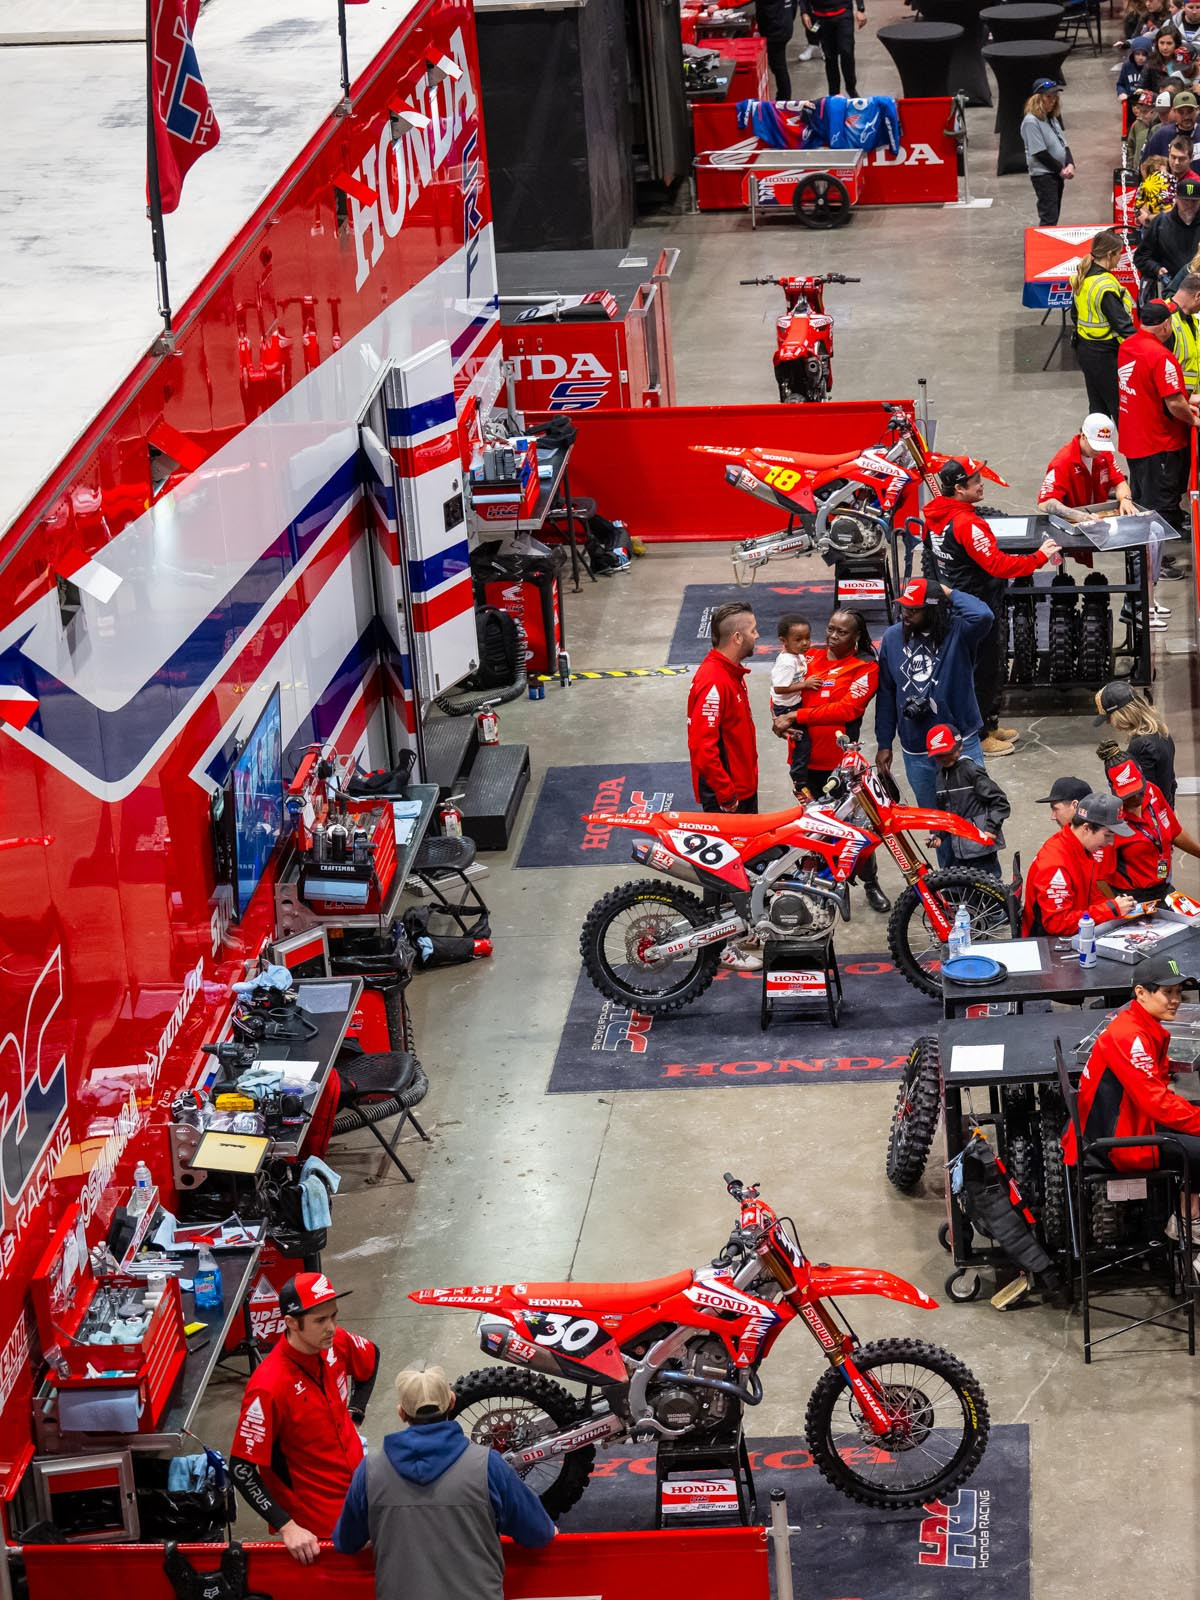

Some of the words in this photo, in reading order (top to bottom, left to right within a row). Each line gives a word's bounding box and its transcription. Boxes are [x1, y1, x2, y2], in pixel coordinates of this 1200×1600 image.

[761, 453, 796, 463] HONDA
[861, 459, 902, 476] HONDA
[767, 465, 802, 492] 18
[843, 581, 880, 589] HONDA
[606, 818, 651, 826] DUNLOP
[678, 821, 721, 833] HONDA
[803, 820, 856, 839] HONDA
[682, 834, 722, 866] 96
[887, 836, 910, 871] SHOWA
[922, 892, 948, 929] DUNLOP
[667, 944, 685, 954] DID
[157, 956, 204, 1083] DUNLOP
[76, 1087, 142, 1227] OSHIMURA
[15, 1117, 72, 1230] RACING
[436, 1296, 495, 1304] DUNLOP
[527, 1298, 584, 1308] HONDA
[696, 1292, 764, 1315] HONDA
[534, 1313, 600, 1352] 30
[802, 1305, 835, 1347] SHOWA
[852, 1377, 889, 1425] DUNLOP
[961, 1391, 977, 1429] DUNLOP
[522, 1449, 545, 1463] DID
[245, 1479, 272, 1511] VIRUS
[671, 1484, 729, 1494] HONDA
[978, 1489, 991, 1527] RACING
[978, 1528, 991, 1569] Honda
